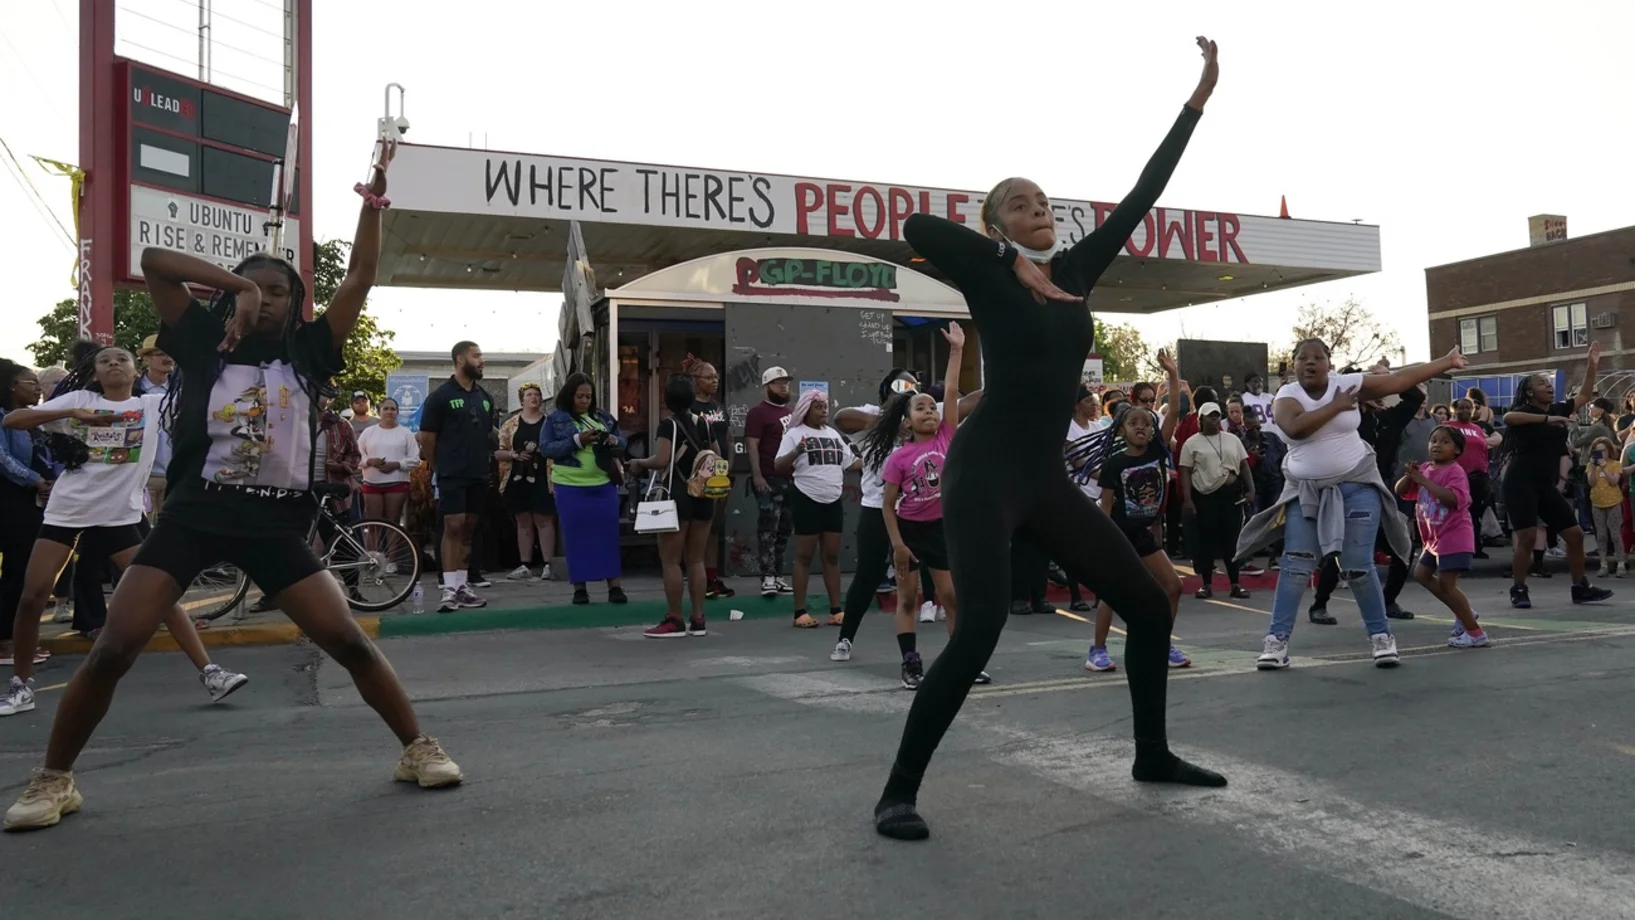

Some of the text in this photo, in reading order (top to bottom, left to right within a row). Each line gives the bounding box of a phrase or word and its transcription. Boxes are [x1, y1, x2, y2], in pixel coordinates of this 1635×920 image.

[485, 158, 618, 213] WHERE
[636, 169, 775, 228] THERE'S
[190, 202, 252, 234] UBUNTU
[140, 221, 185, 249] RISE
[194, 233, 205, 253] &
